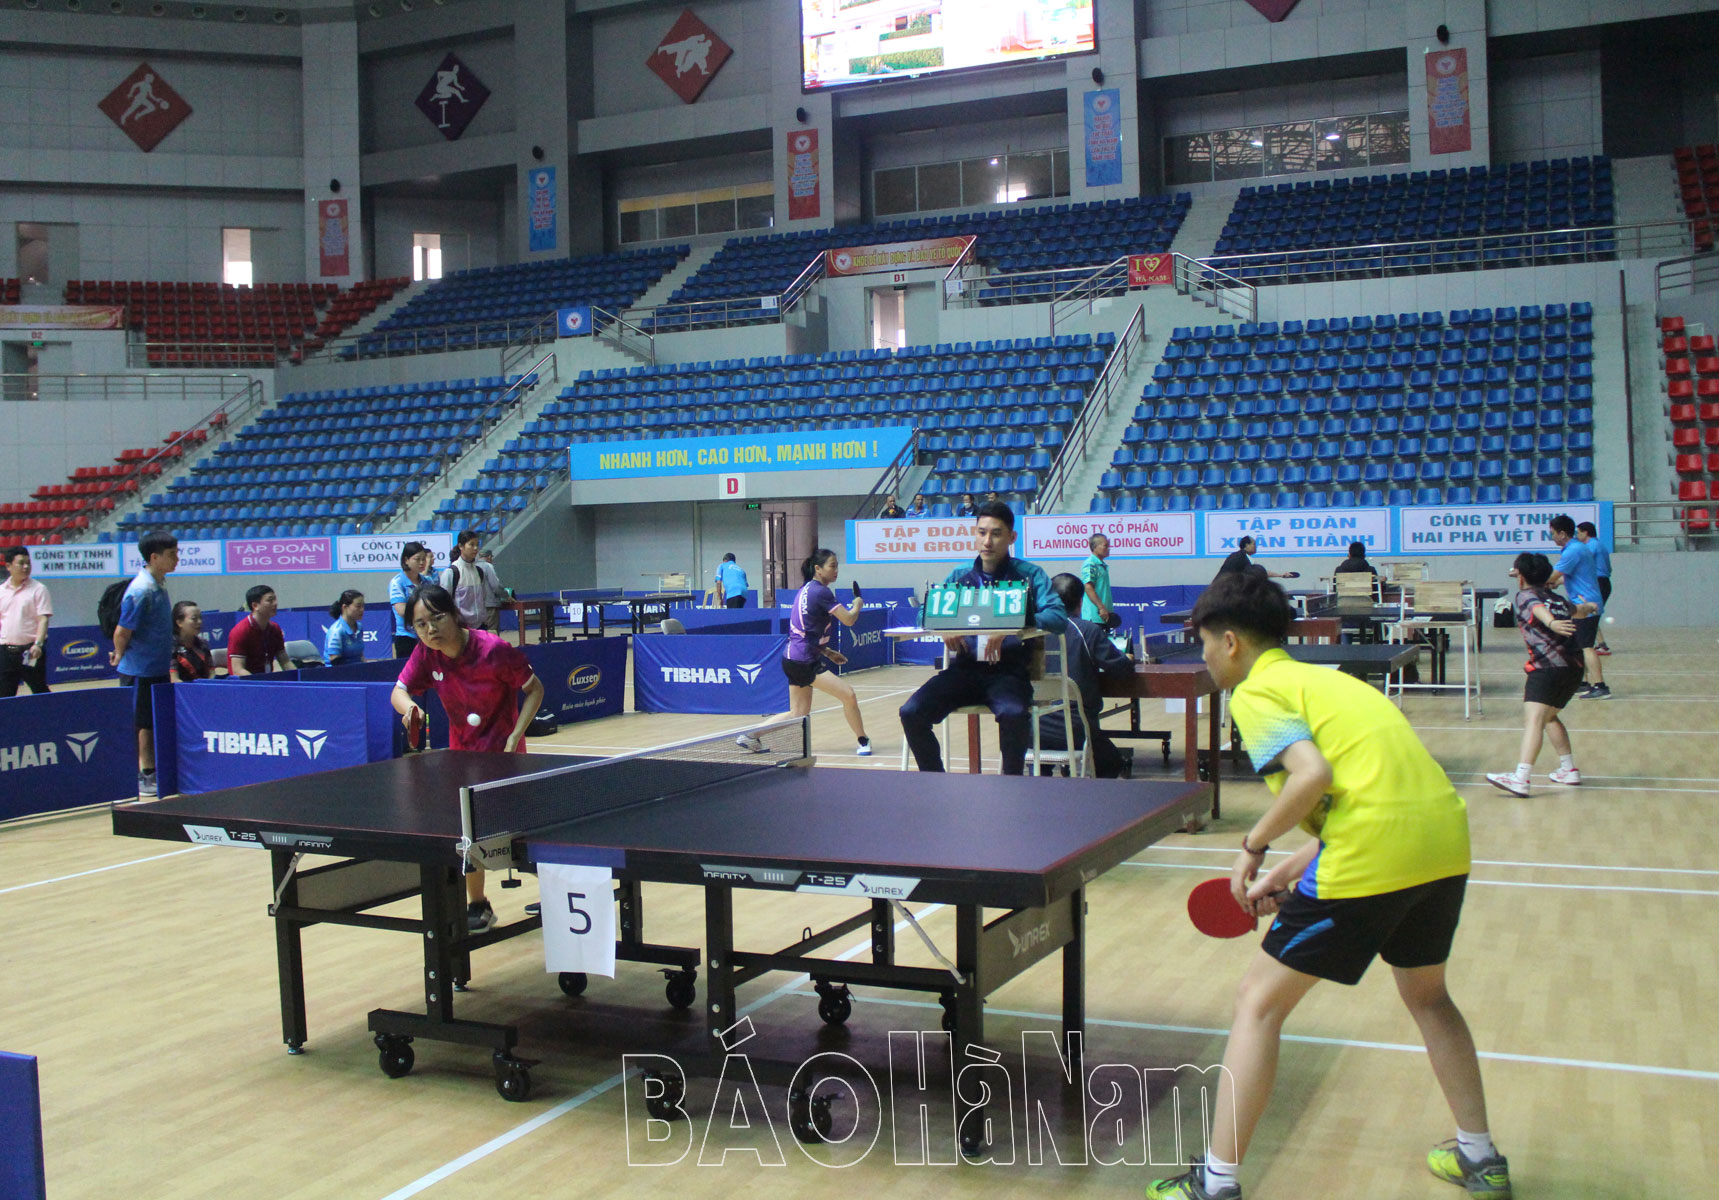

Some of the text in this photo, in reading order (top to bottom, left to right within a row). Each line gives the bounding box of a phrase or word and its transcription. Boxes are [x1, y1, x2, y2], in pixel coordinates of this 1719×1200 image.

[1134, 258, 1141, 272] I
[894, 274, 905, 282] D1
[600, 452, 651, 469] NHANH
[656, 449, 692, 468] HƠN,
[698, 448, 728, 465] CAO
[734, 445, 772, 464] HƠN,
[777, 443, 826, 464] MẠNH
[832, 440, 866, 458] HƠN
[727, 478, 738, 495] D
[1057, 522, 1087, 535] CÔNG
[1091, 524, 1105, 534] TY
[1108, 518, 1124, 533] CỔ
[1237, 515, 1356, 533] TẬP ĐOÀN
[1430, 513, 1567, 526] CÔNG TY TNH
[882, 526, 920, 540] TẬP
[1412, 532, 1443, 543] HAI
[1450, 531, 1487, 543] PHA
[1494, 528, 1534, 544] VIỆT
[361, 540, 392, 550] CÔNG
[875, 541, 978, 553] SUN GROU
[1033, 539, 1089, 549] FLAMINGO
[1145, 537, 1184, 548] GROUP
[1294, 533, 1374, 548] THÀNH
[35, 549, 112, 559] CÔNG TY TNHH
[187, 547, 200, 555] CP
[233, 541, 325, 556] TẬP ĐOÀN
[181, 559, 215, 567] DANKO
[242, 555, 317, 566] BIG ONE
[345, 552, 399, 564] TẬP ĐOÀN
[43, 562, 64, 571] KIM
[932, 591, 956, 615] 12
[963, 590, 972, 605] 0
[981, 590, 989, 605] 0
[995, 589, 1022, 614] 13
[66, 647, 95, 655] Luxsen
[572, 674, 599, 686] Luxsen
[661, 667, 731, 684] TIBHAR
[203, 731, 289, 756] TIBHAR
[230, 831, 256, 841] T-25
[299, 841, 331, 849] INFINITY
[704, 871, 747, 880] INFINITY
[807, 874, 846, 885] T-25
[567, 892, 592, 935] 5
